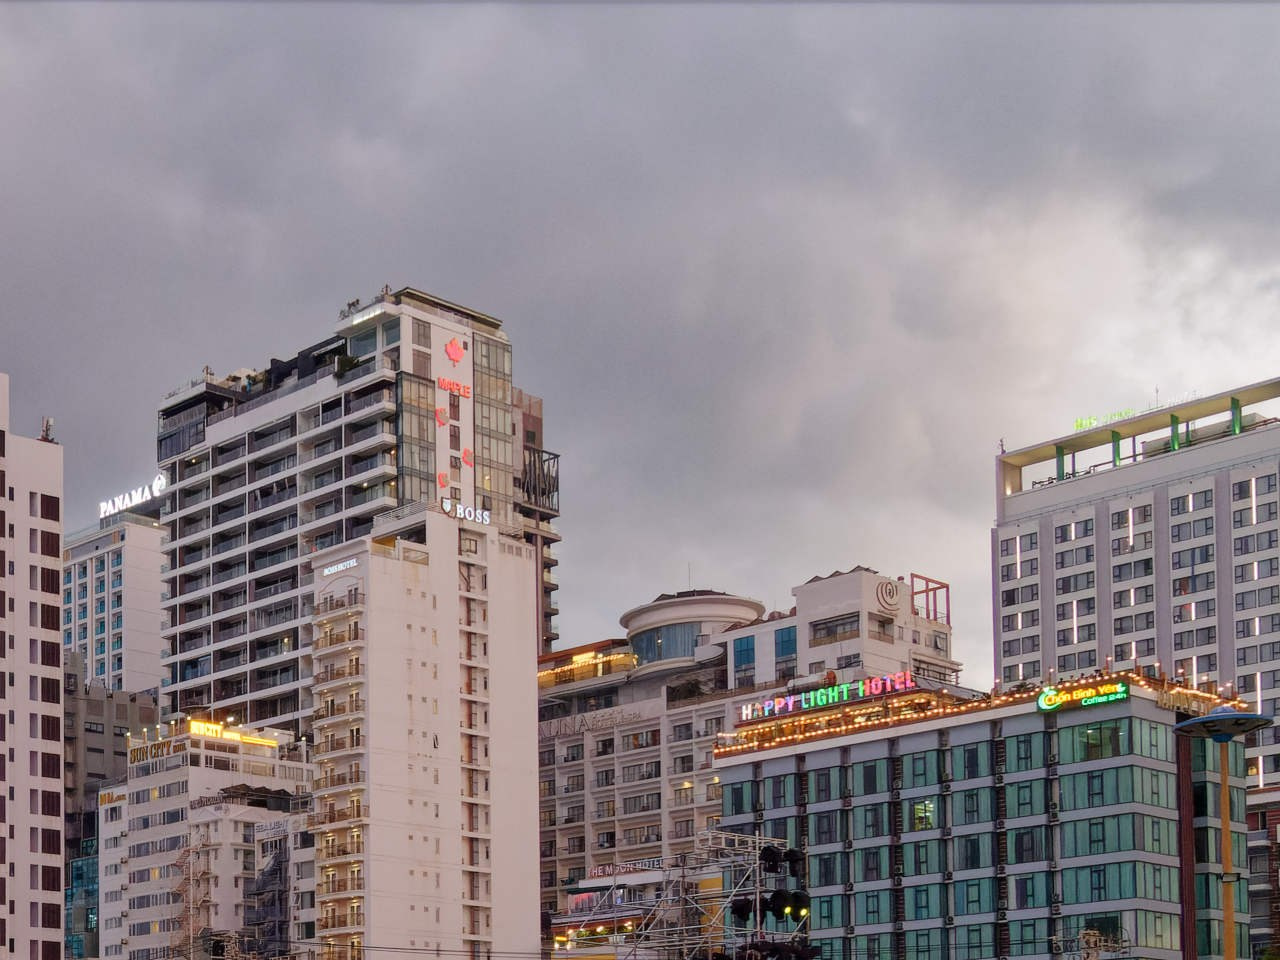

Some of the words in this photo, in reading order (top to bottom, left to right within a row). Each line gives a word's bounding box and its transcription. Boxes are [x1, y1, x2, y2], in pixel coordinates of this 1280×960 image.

[437, 376, 472, 399] MAPLE
[99, 485, 152, 519] PANAMA
[456, 503, 490, 525] BOSS
[741, 695, 796, 721] HAPPY
[801, 684, 850, 709] LIGHT
[858, 671, 916, 697] HOTEL
[1081, 695, 1108, 706] Coffee
[190, 720, 205, 735] SUN
[205, 722, 223, 738] CITY
[130, 746, 149, 764] SUN
[149, 740, 172, 758] CITY
